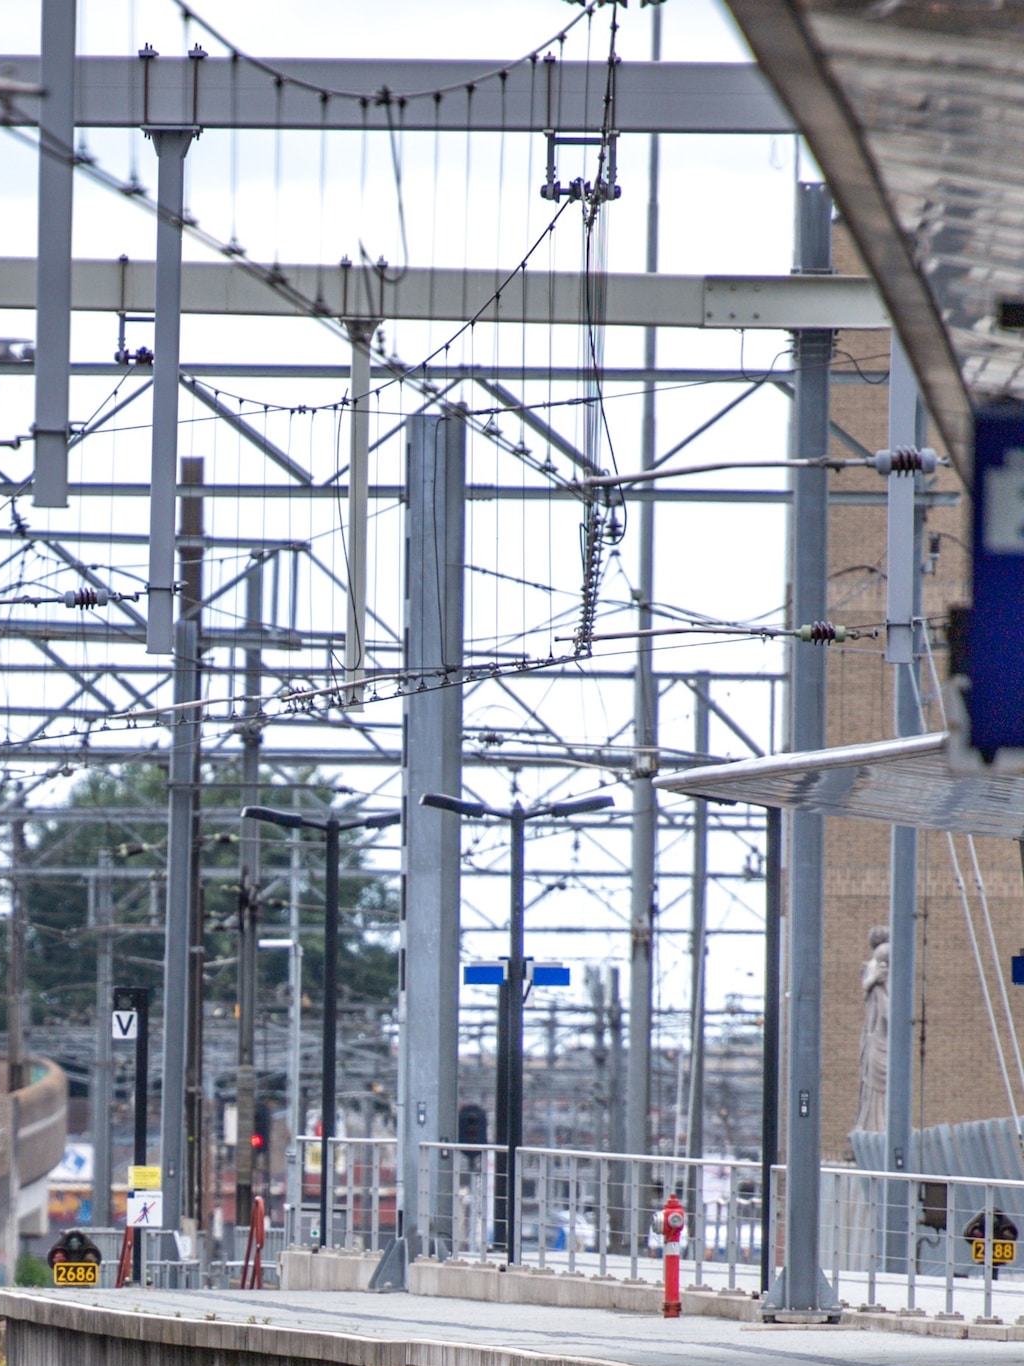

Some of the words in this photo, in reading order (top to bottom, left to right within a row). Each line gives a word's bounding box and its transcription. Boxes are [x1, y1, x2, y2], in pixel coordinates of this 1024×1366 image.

[115, 1014, 135, 1036] V
[976, 1243, 1013, 1259] 288
[57, 1266, 95, 1282] 2686
